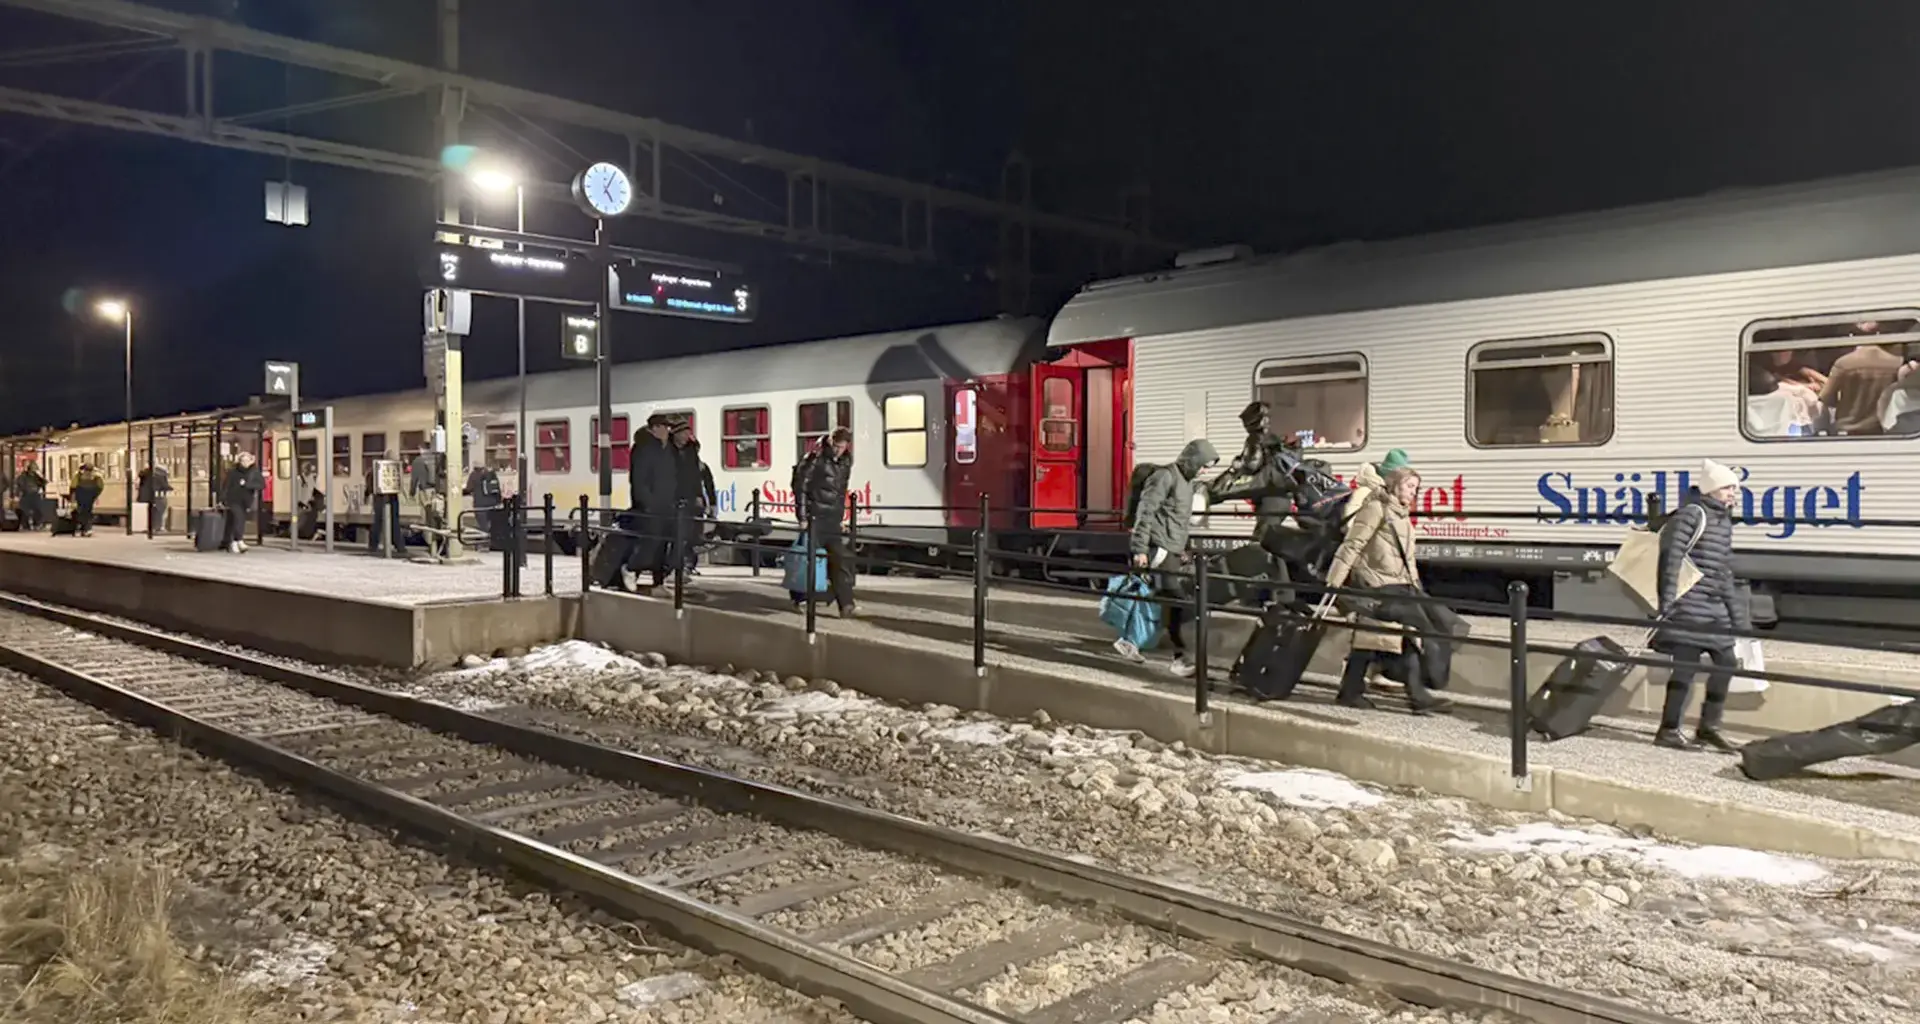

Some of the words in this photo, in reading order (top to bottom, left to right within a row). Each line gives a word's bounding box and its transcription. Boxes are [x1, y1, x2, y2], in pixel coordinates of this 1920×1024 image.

[443, 263, 457, 280] 2
[737, 297, 747, 311] 3
[273, 376, 286, 390] A
